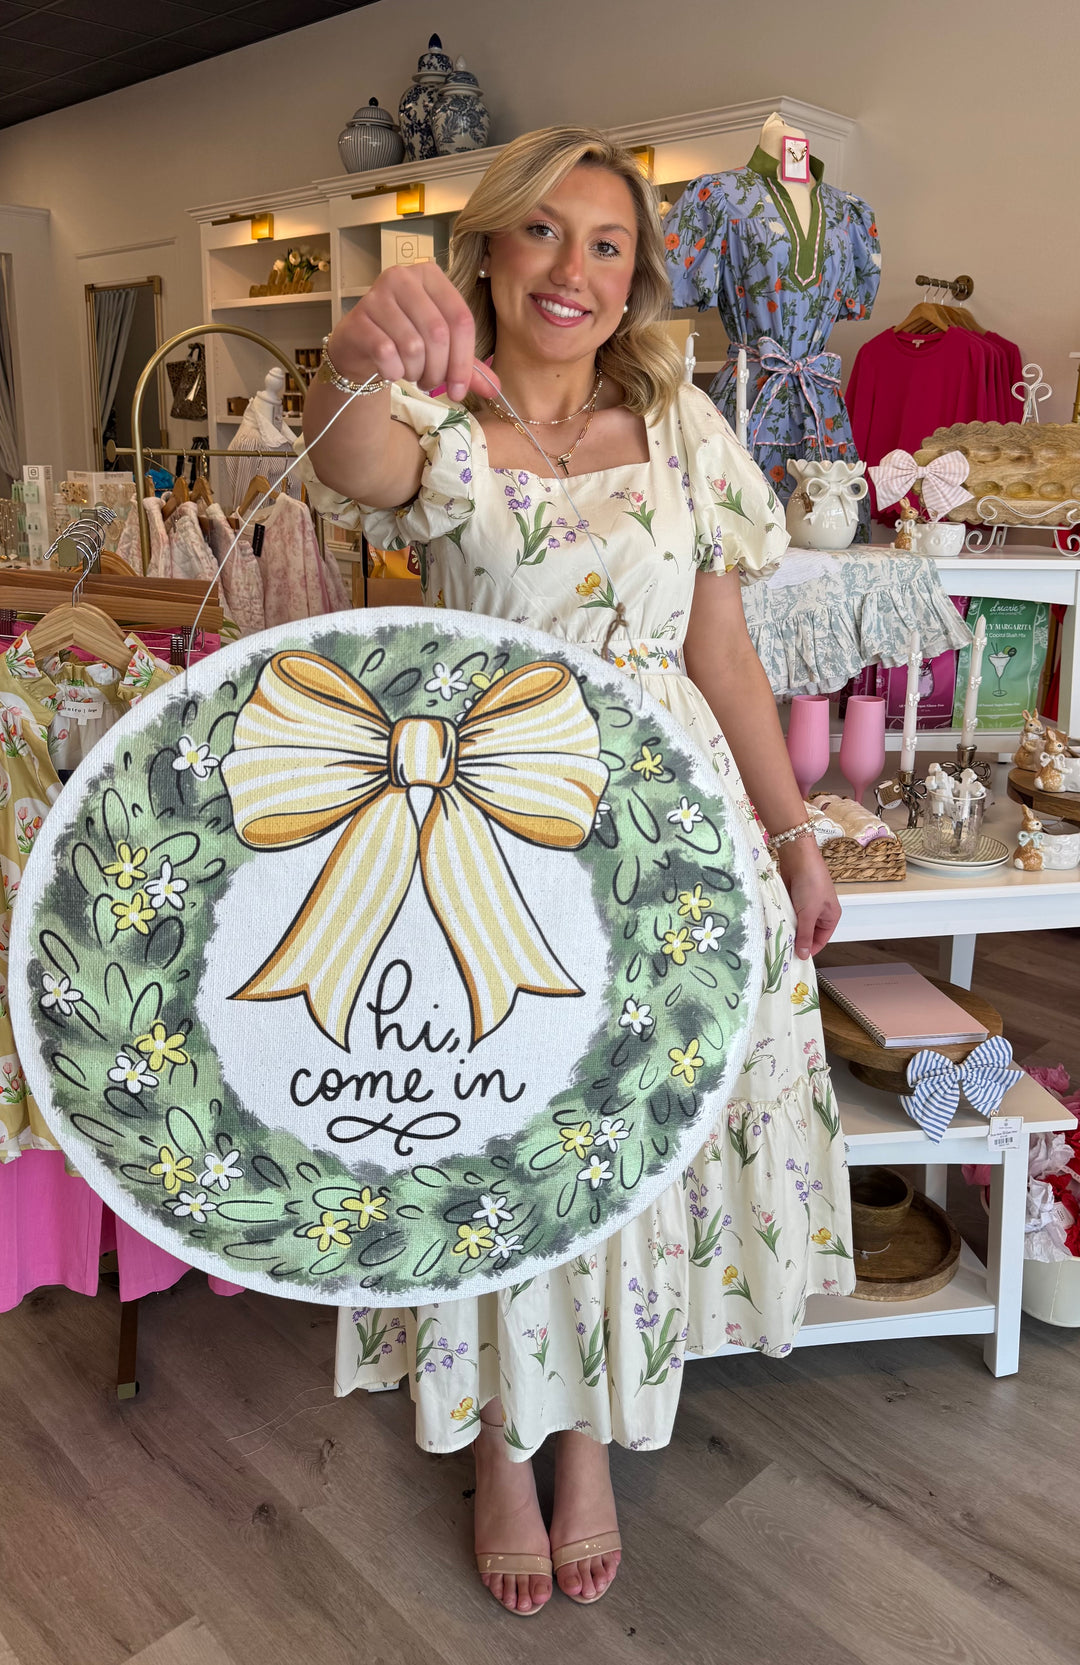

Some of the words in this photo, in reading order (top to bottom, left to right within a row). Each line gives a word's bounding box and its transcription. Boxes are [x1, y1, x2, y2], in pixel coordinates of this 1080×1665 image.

[995, 623, 1032, 631] MARGARITA
[366, 959, 460, 1053] hi,
[290, 1067, 434, 1107] come
[453, 1058, 526, 1103] in
